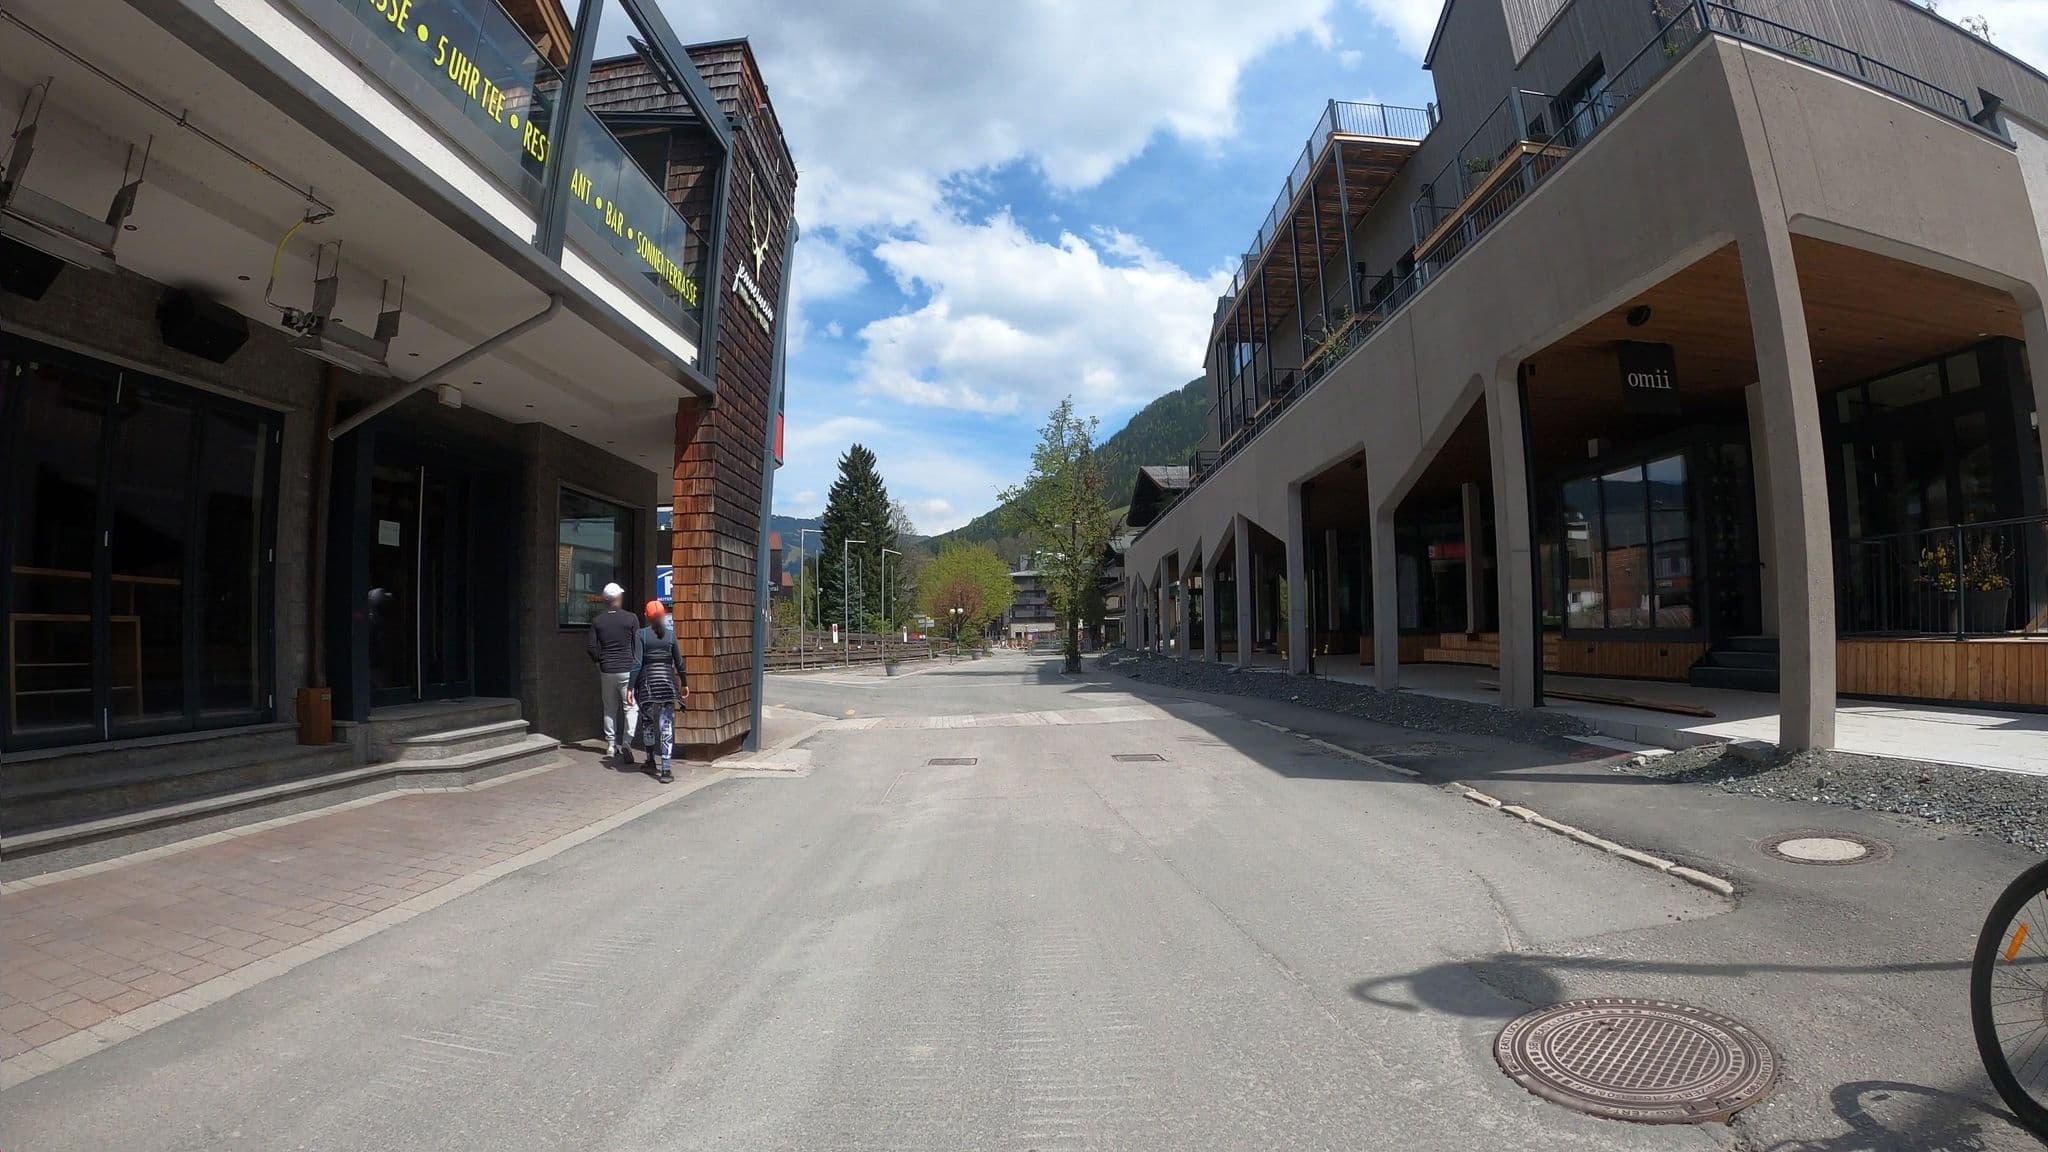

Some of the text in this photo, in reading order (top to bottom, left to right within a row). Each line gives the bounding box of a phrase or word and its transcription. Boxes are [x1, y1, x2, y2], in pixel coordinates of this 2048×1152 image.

[434, 35, 448, 65] 5
[448, 47, 480, 100] UHR
[481, 78, 506, 123] TEE
[605, 201, 624, 237] BAR
[636, 231, 697, 306] SONNENTERRASSE
[1628, 369, 1672, 389] omii
